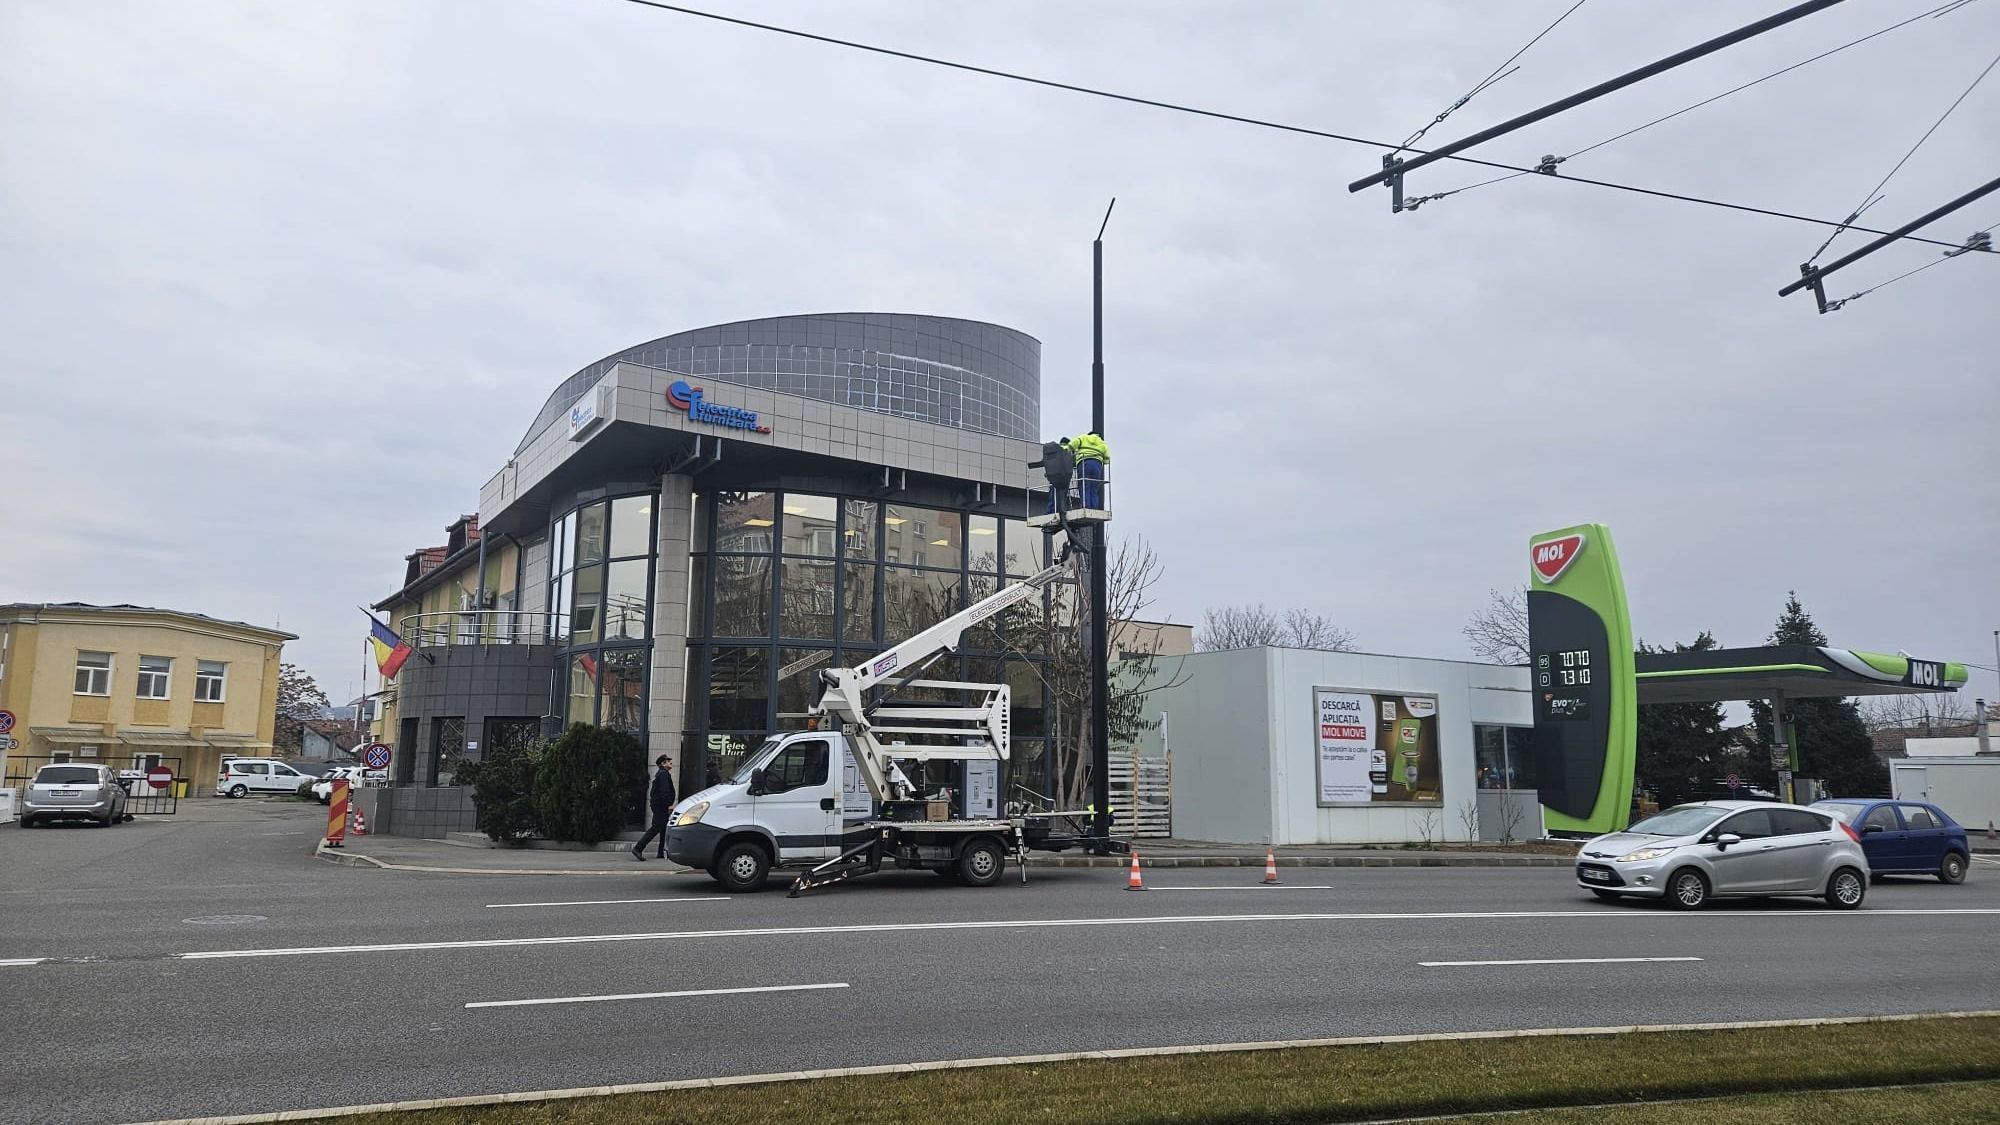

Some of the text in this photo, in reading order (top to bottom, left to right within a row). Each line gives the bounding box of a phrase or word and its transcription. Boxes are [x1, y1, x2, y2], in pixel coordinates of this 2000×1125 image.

[698, 401, 760, 422] electrica
[698, 411, 759, 432] furnizare
[1537, 543, 1565, 564] MOL
[971, 589, 1022, 620] ELECTRO CONSULT
[1540, 657, 1549, 667] 95
[1542, 675, 1548, 684] D
[1912, 661, 1940, 687] MOL
[1322, 700, 1361, 711] DESCARCĂ
[1551, 699, 1568, 708] EVO
[1323, 727, 1366, 738] MOL MOVE
